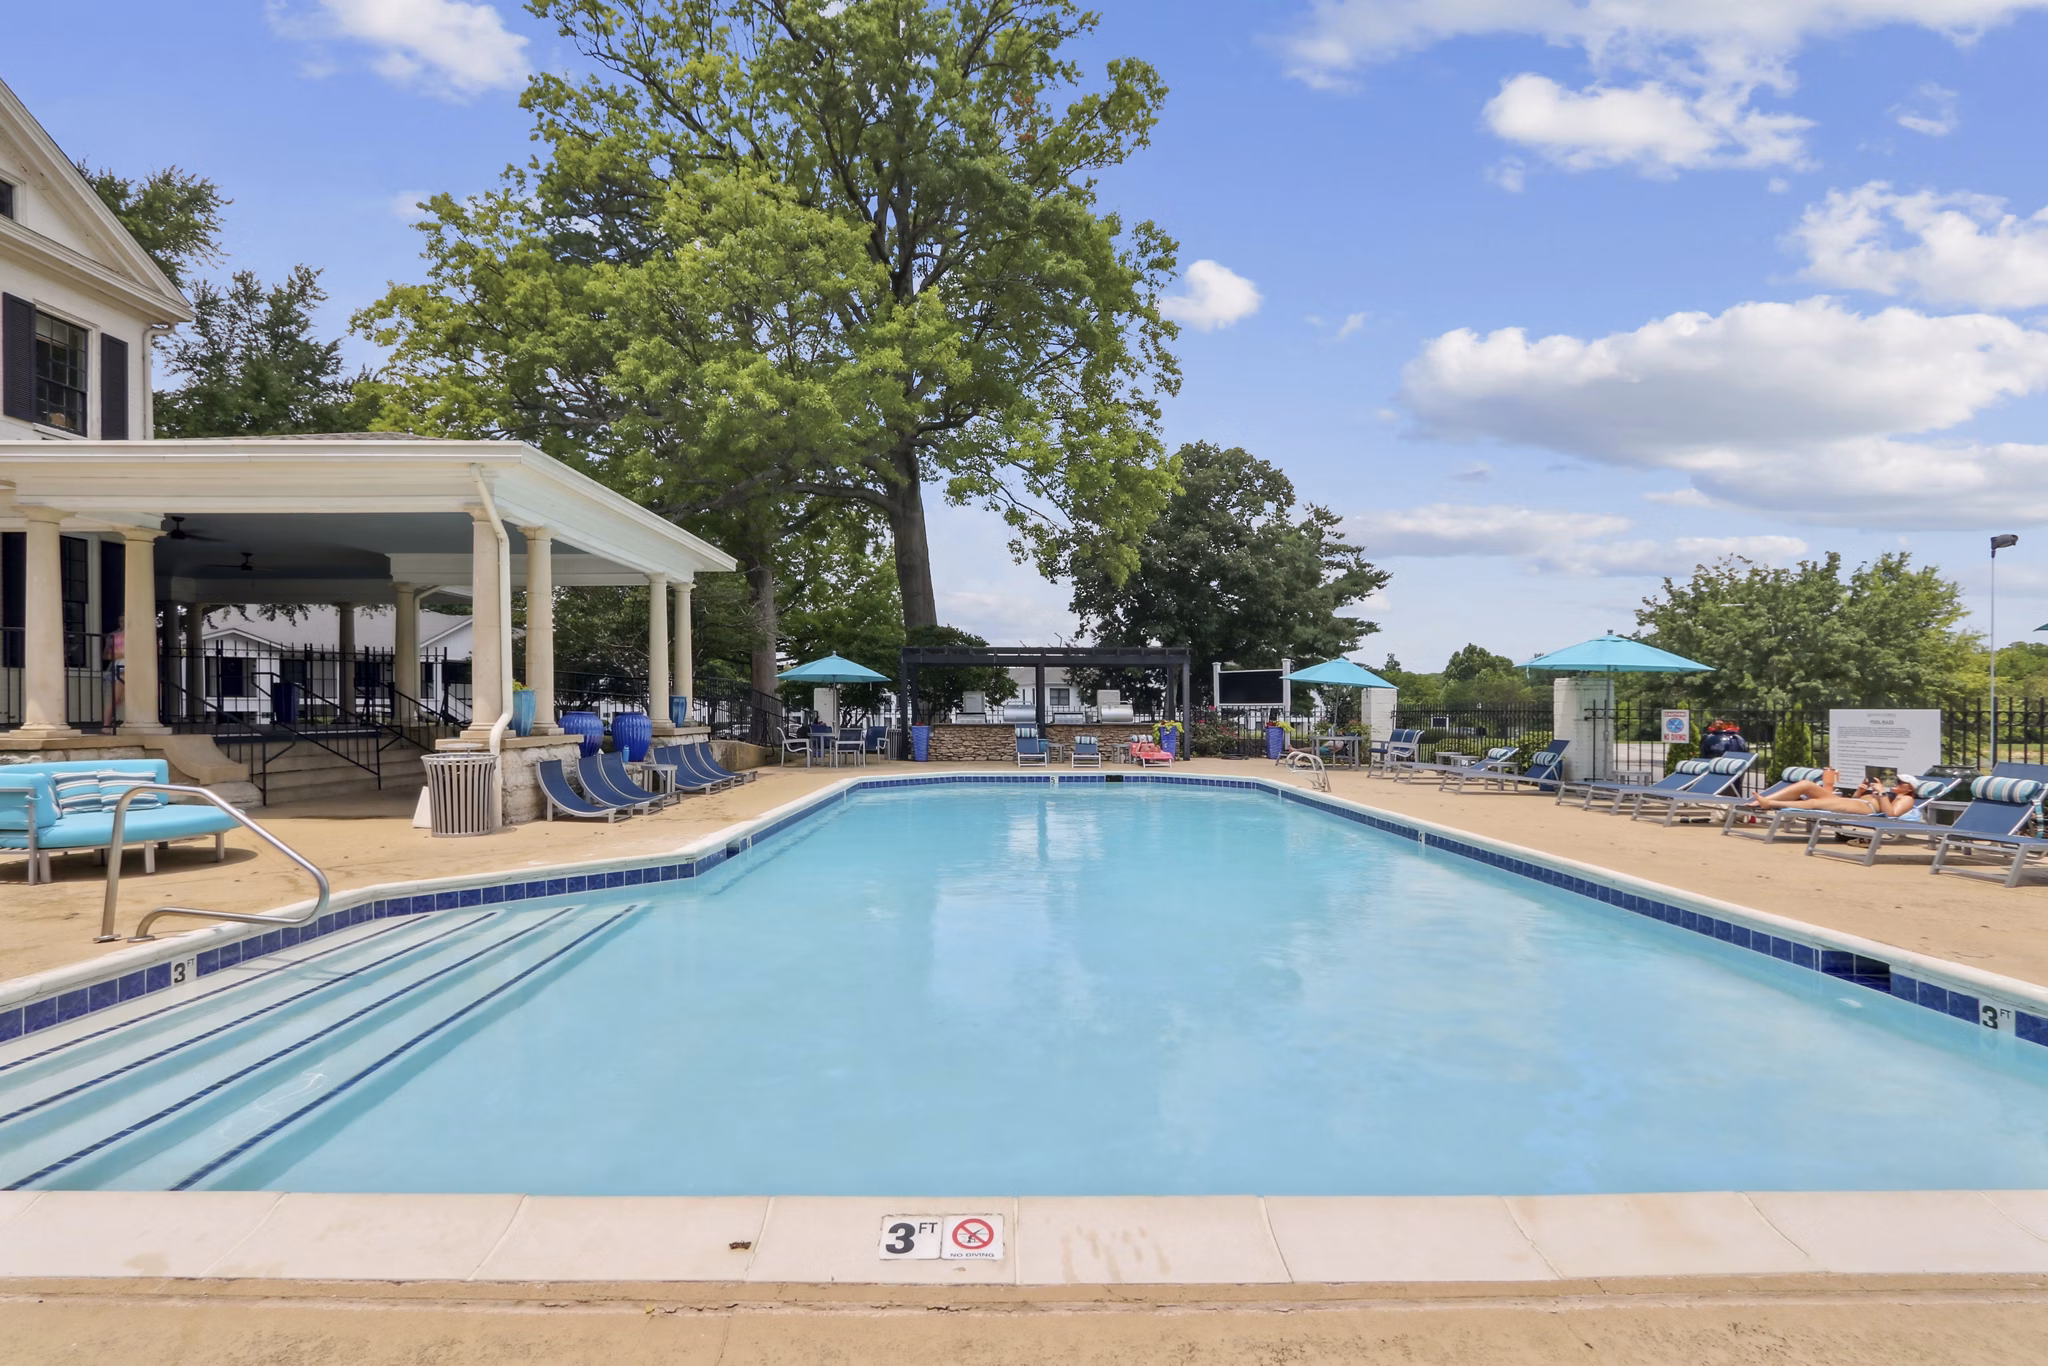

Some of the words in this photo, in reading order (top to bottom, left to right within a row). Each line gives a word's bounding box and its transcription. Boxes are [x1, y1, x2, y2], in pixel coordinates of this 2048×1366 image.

[174, 962, 185, 983] 3
[187, 958, 195, 967] FT
[1982, 1005, 1998, 1029] 3
[2000, 1008, 2011, 1019] FT
[885, 1222, 916, 1254] 3
[918, 1222, 938, 1234] FT
